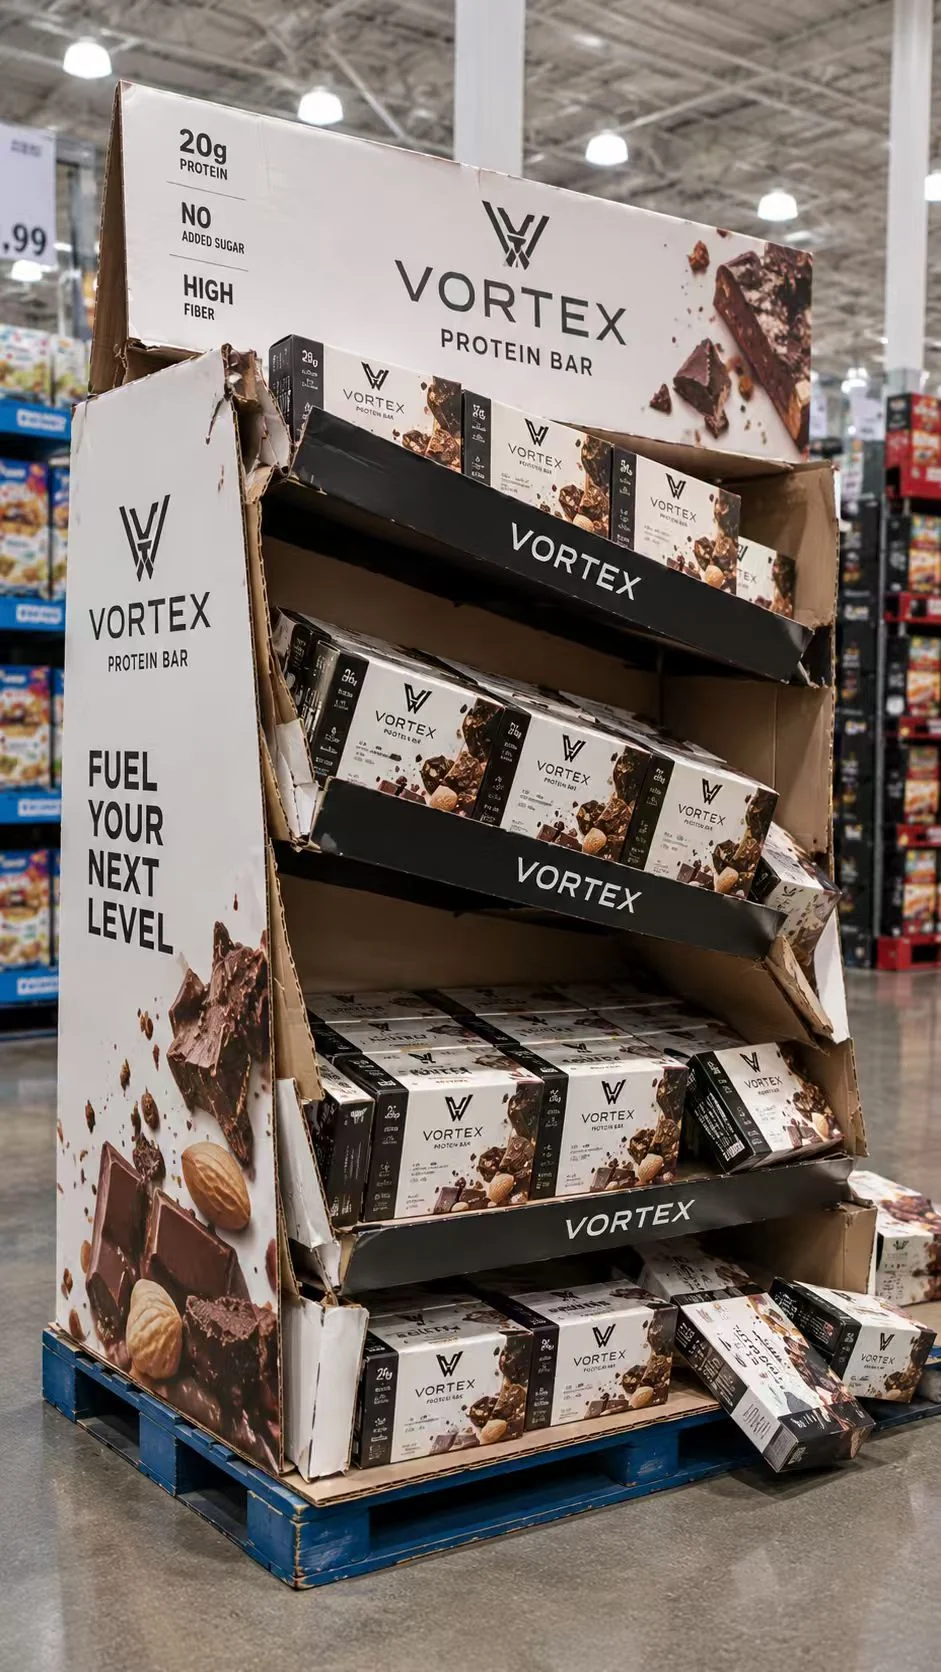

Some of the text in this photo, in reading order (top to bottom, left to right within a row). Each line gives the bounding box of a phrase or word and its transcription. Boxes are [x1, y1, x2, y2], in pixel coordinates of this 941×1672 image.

[179, 128, 228, 165] 20g
[179, 158, 228, 181] PROTEIN
[181, 201, 212, 229] NO
[181, 231, 245, 255] ADDED SUGAR
[183, 274, 234, 305] HIGH
[394, 259, 627, 346] VORTEX
[184, 303, 216, 321] FIBER
[441, 329, 593, 376] PROTEIN BAR
[343, 389, 405, 414] VORTEX
[508, 443, 562, 470] VORTEX
[650, 497, 697, 523] VORTEX
[511, 522, 642, 600] VORTEX
[737, 568, 757, 584] TEX
[88, 591, 211, 641] VORTEX
[108, 649, 188, 673] PROTEIN BAR
[376, 710, 436, 739] VORTEX
[88, 749, 158, 792] FUEL
[537, 760, 590, 786] VORTEX
[87, 799, 164, 847] YOUR
[679, 804, 726, 826] VORTEX
[88, 848, 160, 898] NEXT
[517, 857, 642, 914] VORTEX
[88, 897, 174, 955] LEVEL
[744, 1076, 783, 1088] VORTEX
[581, 1109, 635, 1123] VORTEX
[423, 1126, 483, 1141] VORTEX
[565, 1199, 696, 1240] VORTEX
[573, 1350, 626, 1366] VORTEX
[861, 1353, 896, 1365] VORTEX
[415, 1379, 475, 1398] VORTEX
